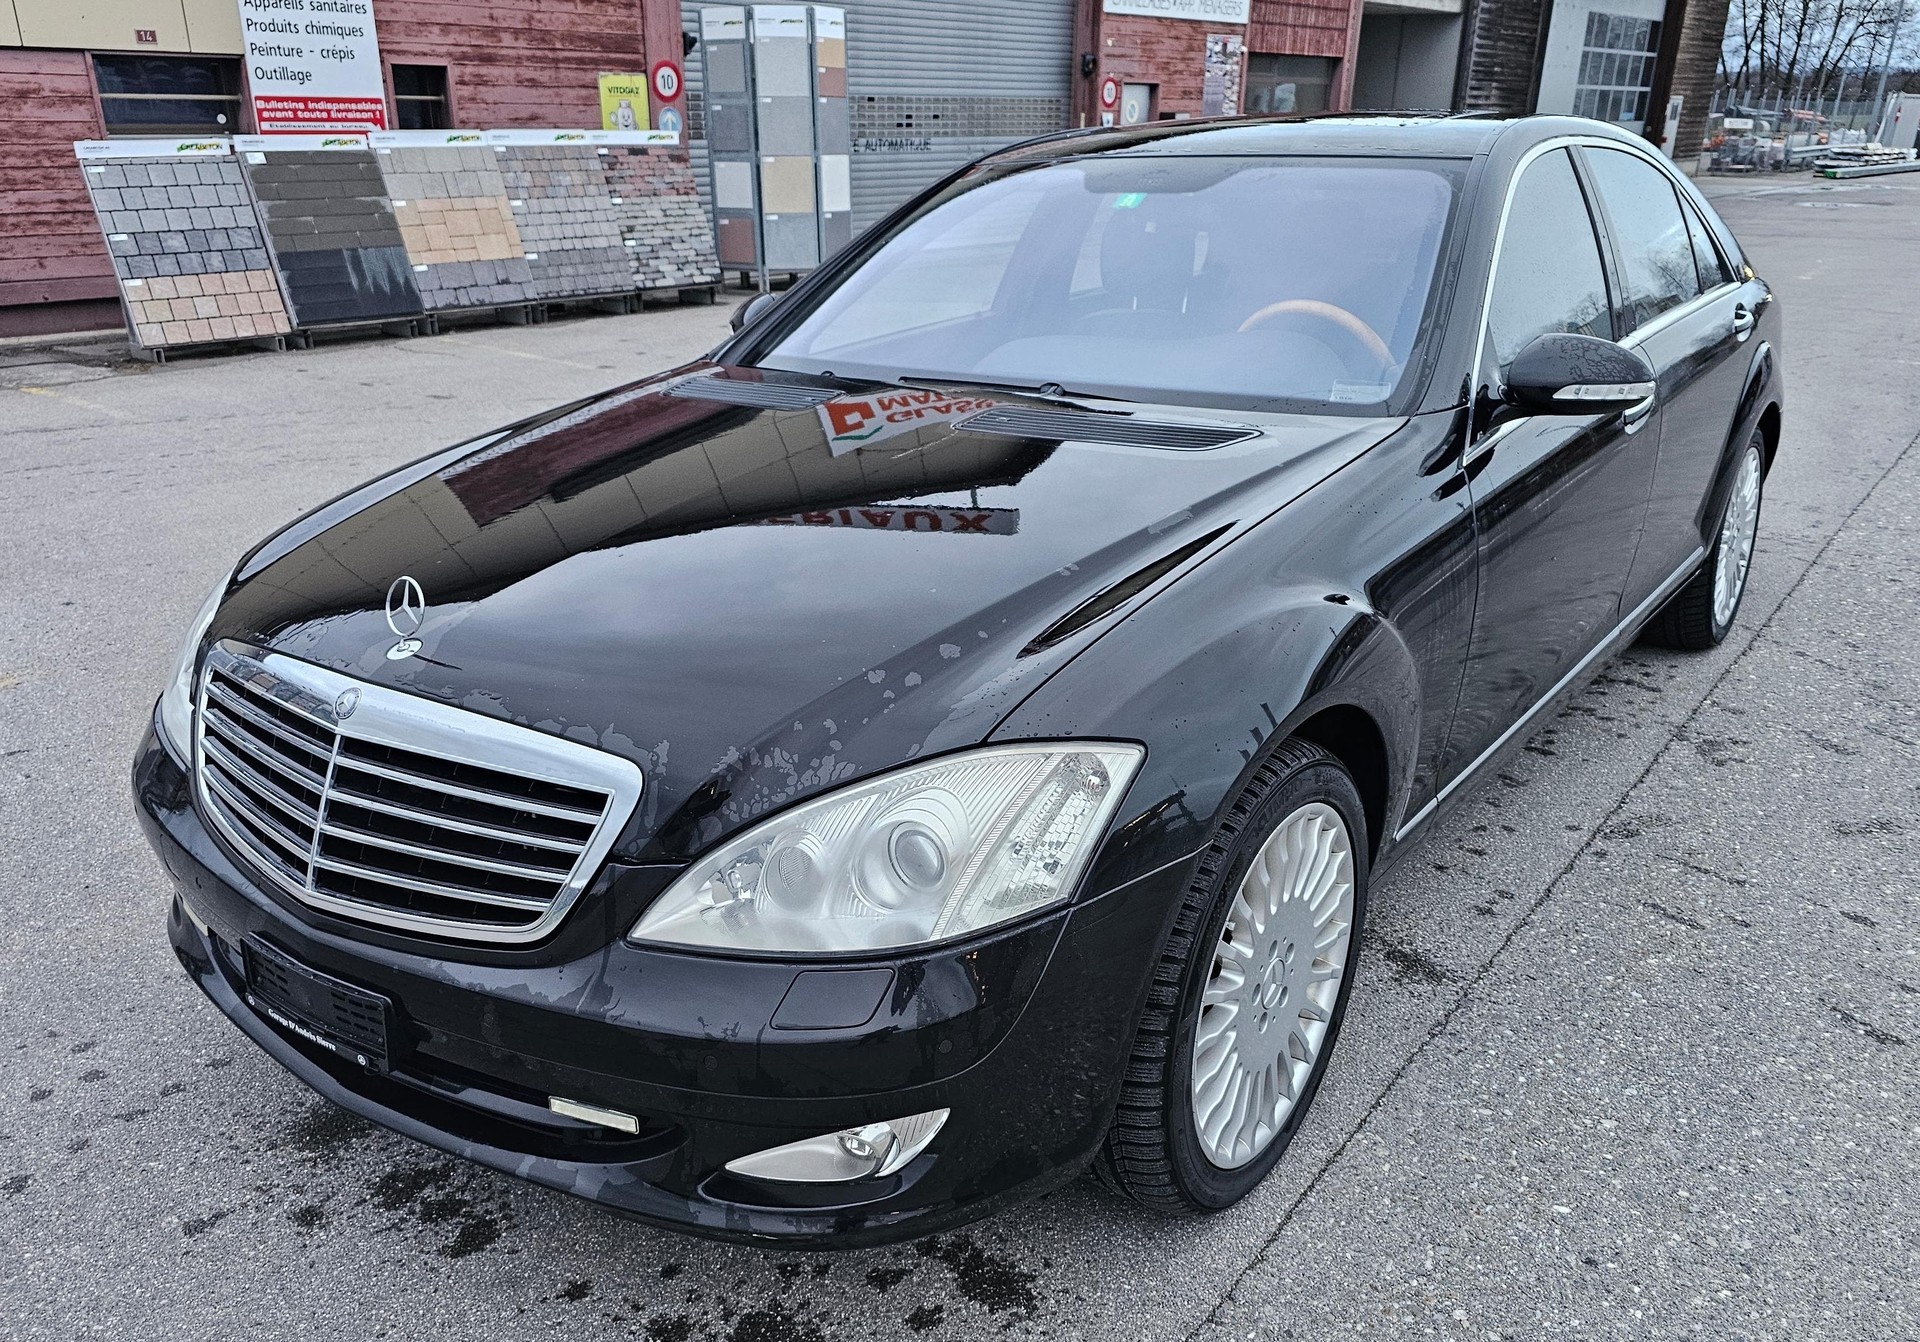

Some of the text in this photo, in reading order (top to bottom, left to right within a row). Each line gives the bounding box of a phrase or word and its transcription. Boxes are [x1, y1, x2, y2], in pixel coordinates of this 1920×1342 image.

[310, 0, 367, 14] sanitaires
[140, 31, 153, 41] 14
[246, 18, 364, 39] Produits chimiques
[250, 42, 303, 58] Peinture
[320, 44, 356, 62] crépis
[254, 66, 312, 85] Outillage
[661, 74, 674, 90] 10
[256, 100, 383, 110] Bulletins indispensables
[262, 110, 294, 118] avant
[297, 110, 328, 119] toute
[330, 109, 374, 119] livraison
